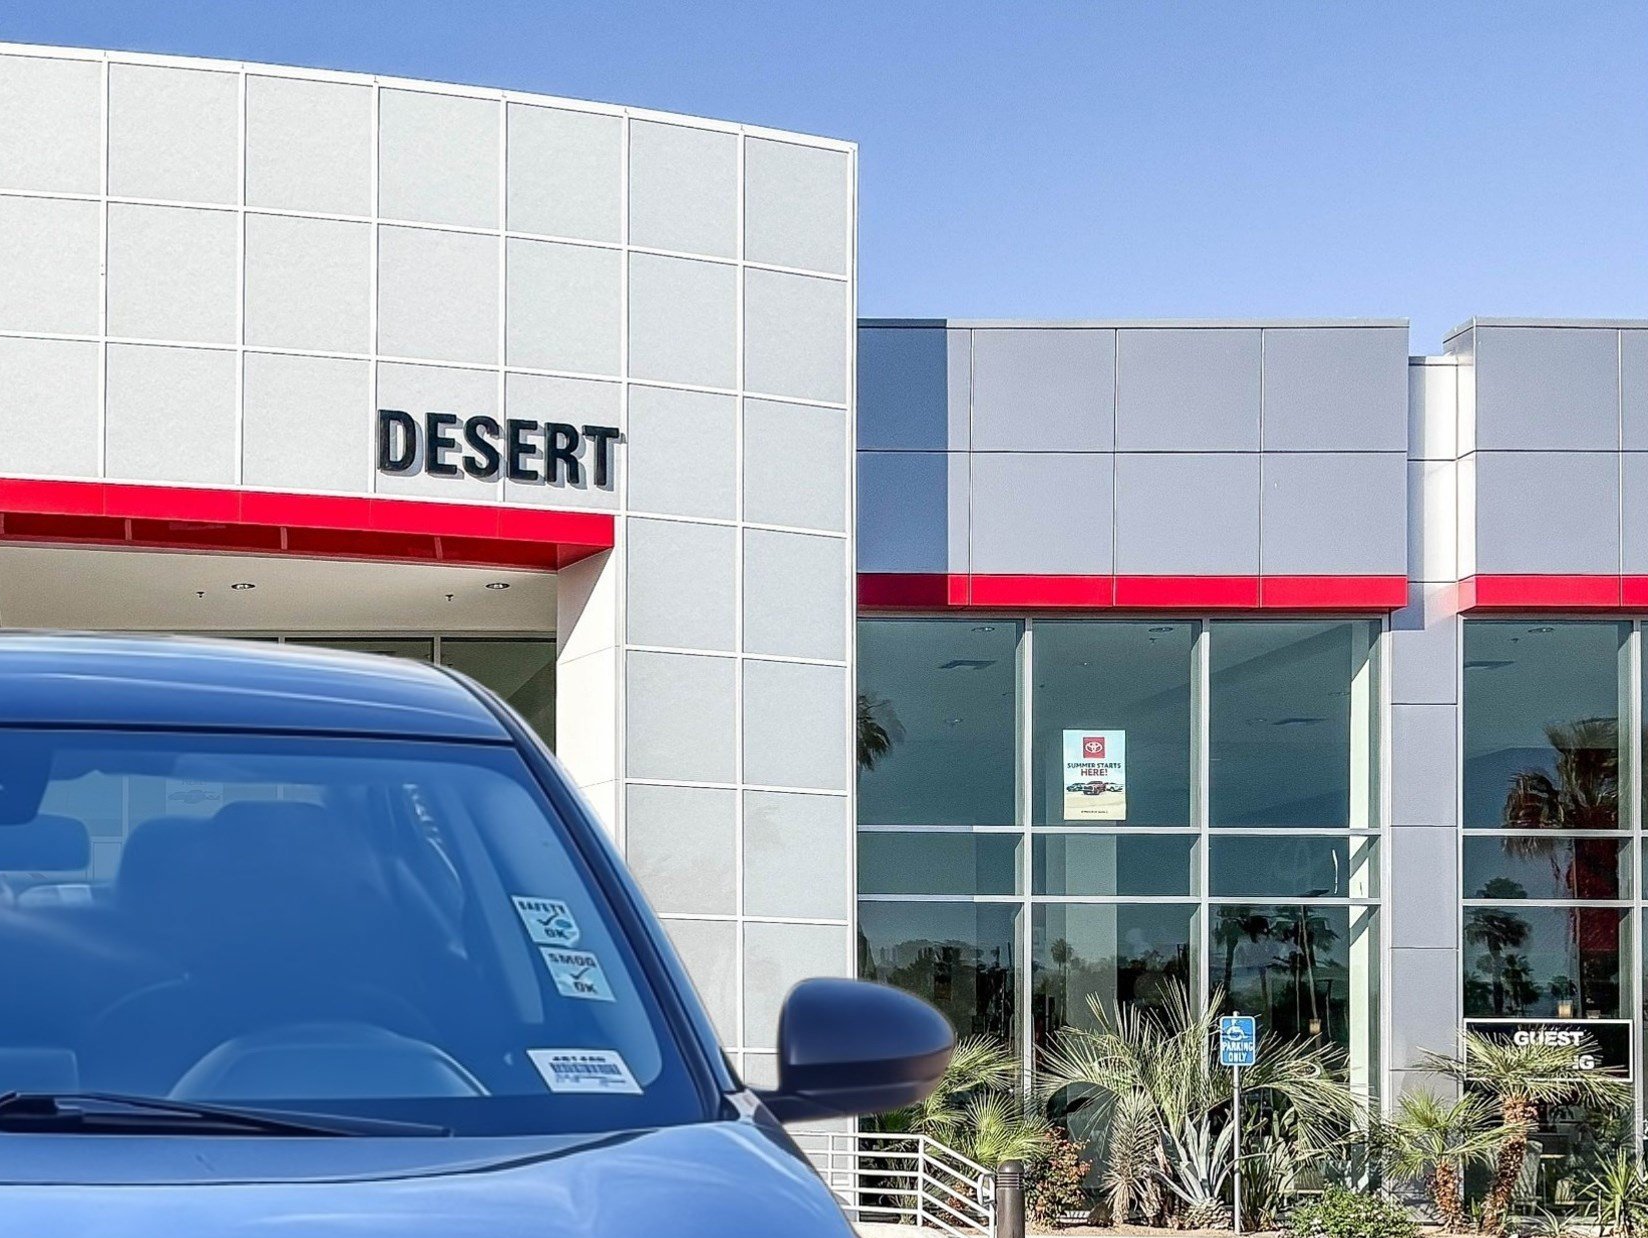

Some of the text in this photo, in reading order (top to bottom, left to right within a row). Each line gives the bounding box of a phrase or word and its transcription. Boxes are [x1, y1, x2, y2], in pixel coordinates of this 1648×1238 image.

[377, 409, 620, 487] DESERT
[1080, 768, 1108, 776] HERE!
[517, 900, 566, 914] SAFETY
[544, 927, 567, 940] OK
[548, 953, 596, 968] SMOG
[572, 981, 598, 994] OK
[1513, 1030, 1585, 1047] GUEST
[1222, 1041, 1254, 1052] PARKING
[1228, 1051, 1248, 1063] ONLY
